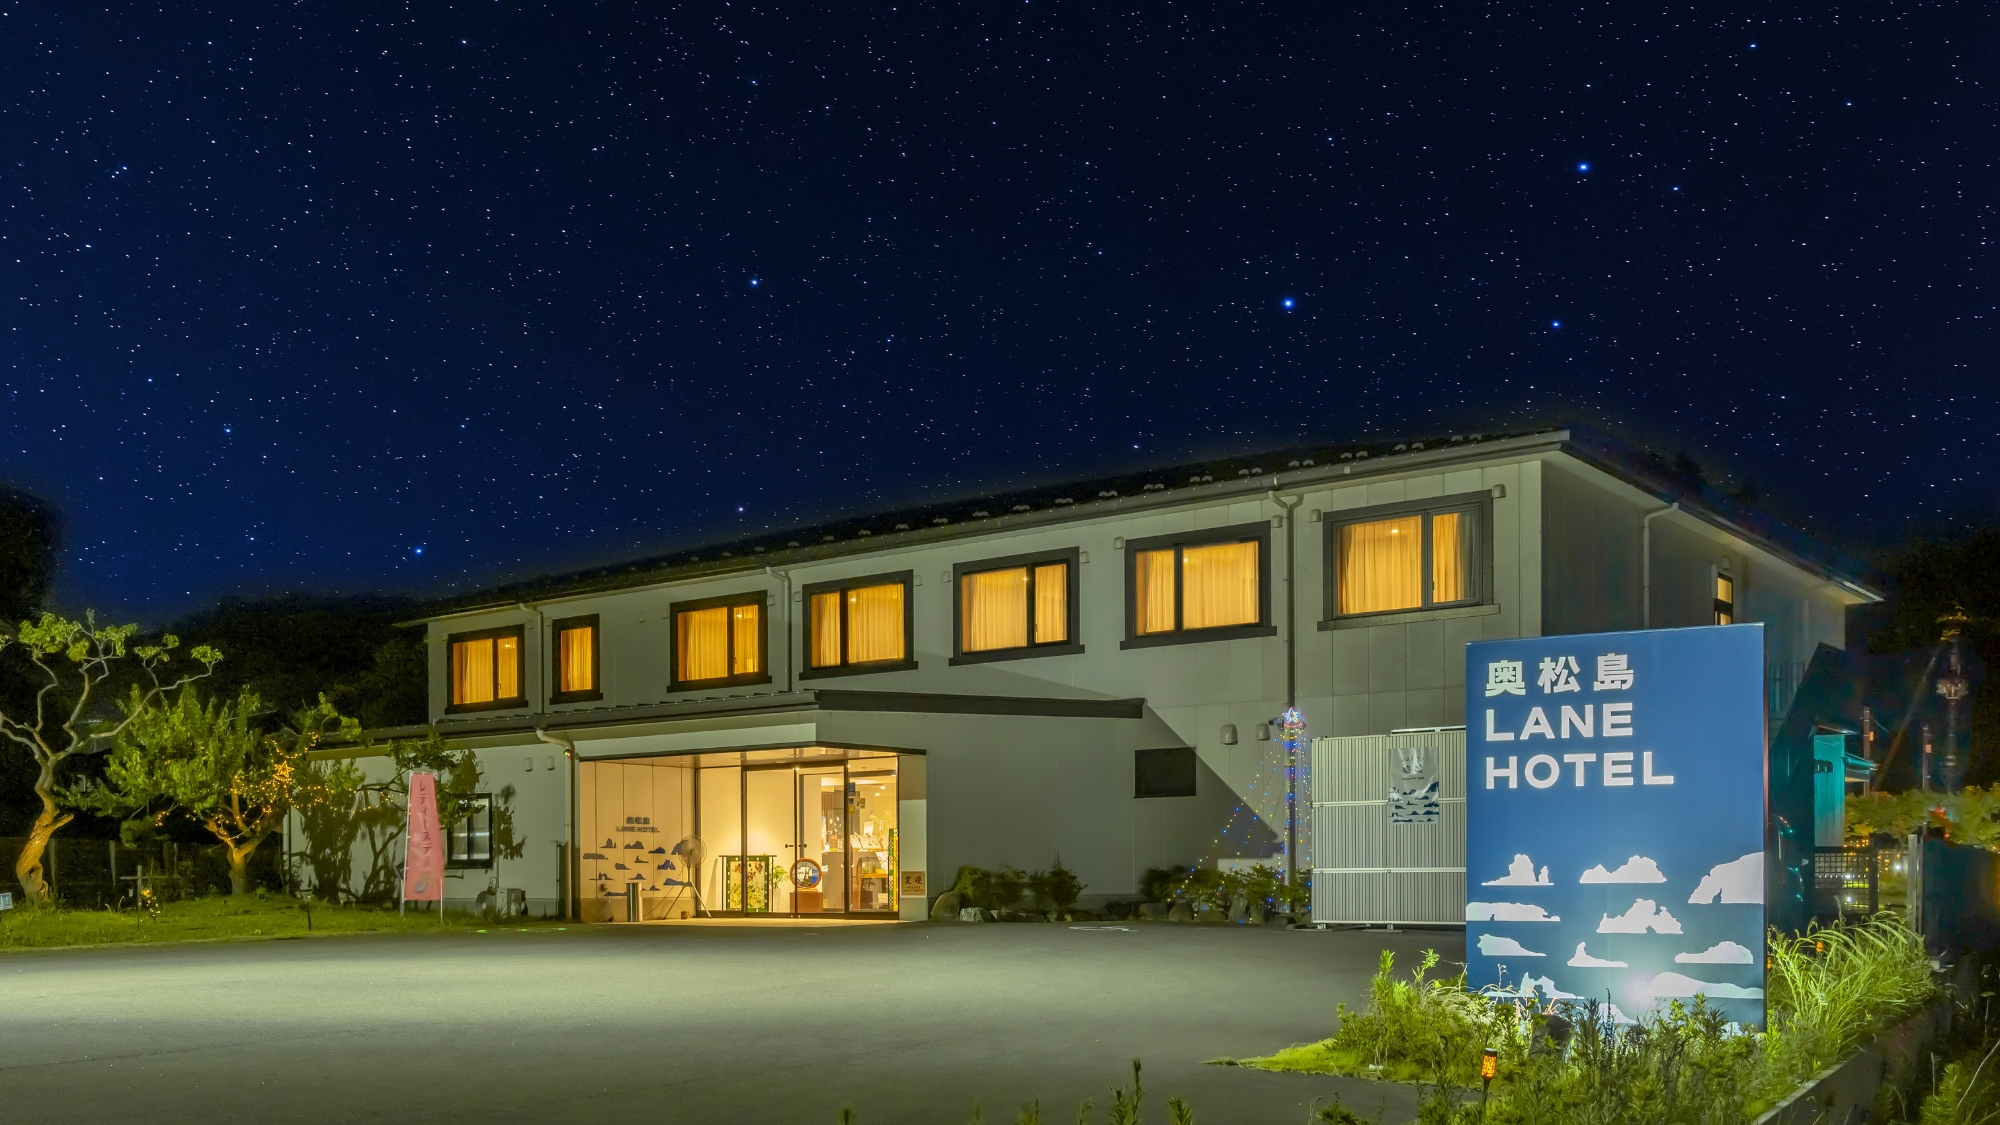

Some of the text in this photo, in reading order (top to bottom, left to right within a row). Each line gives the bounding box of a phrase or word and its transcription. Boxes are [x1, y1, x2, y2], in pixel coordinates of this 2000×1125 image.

[1485, 652, 1635, 697] 奥松島
[1485, 702, 1634, 742] LANE
[1485, 751, 1675, 790] HOTEL
